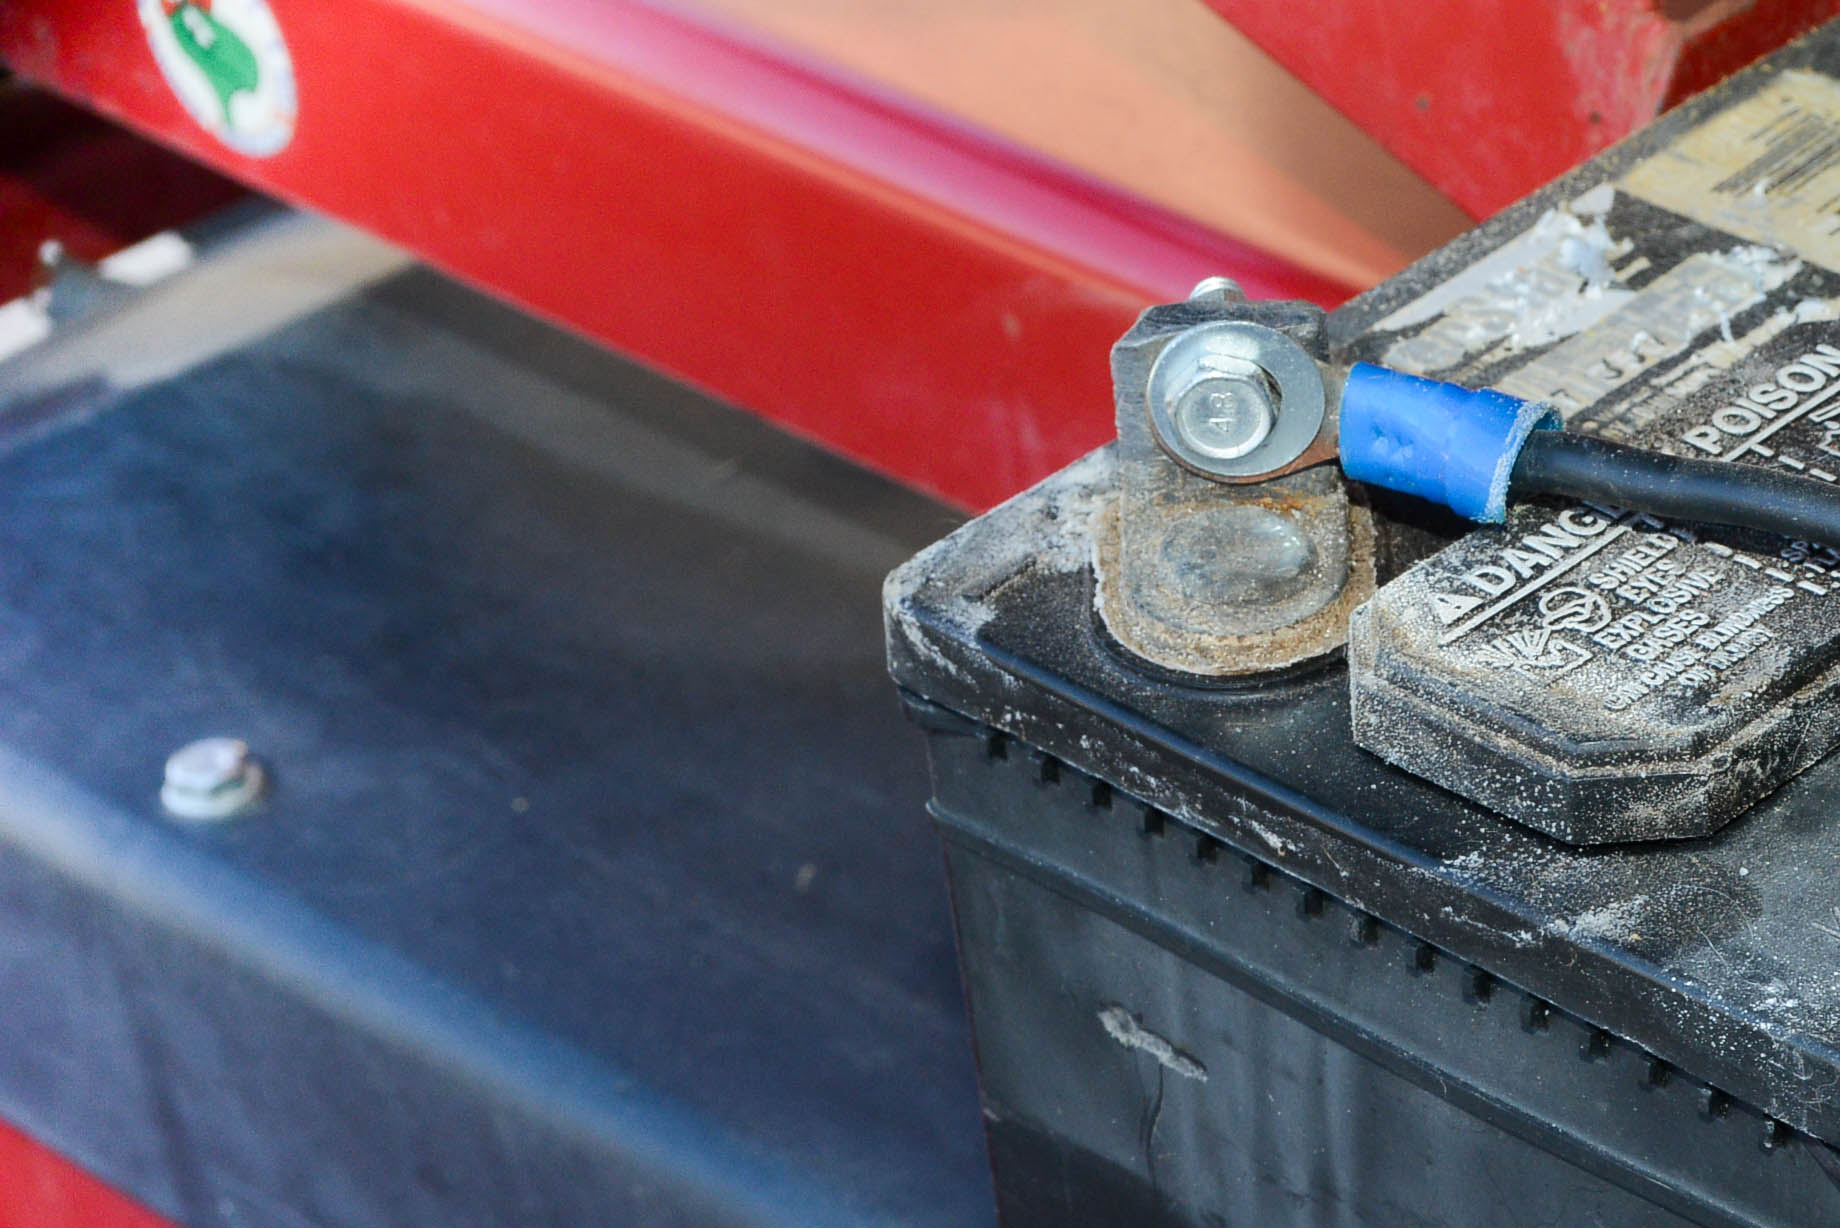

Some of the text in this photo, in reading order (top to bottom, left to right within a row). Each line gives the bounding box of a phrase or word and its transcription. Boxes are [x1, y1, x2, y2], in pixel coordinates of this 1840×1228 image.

[1464, 501, 1628, 597] DANG
[1589, 533, 1679, 590] SHIELD
[1616, 557, 1688, 604] EYES
[1593, 569, 1725, 650] EXPLOSIVE
[1626, 608, 1709, 661] GASES
[1641, 646, 1705, 686] CAUSE
[1695, 585, 1795, 650] BLINDNESS
